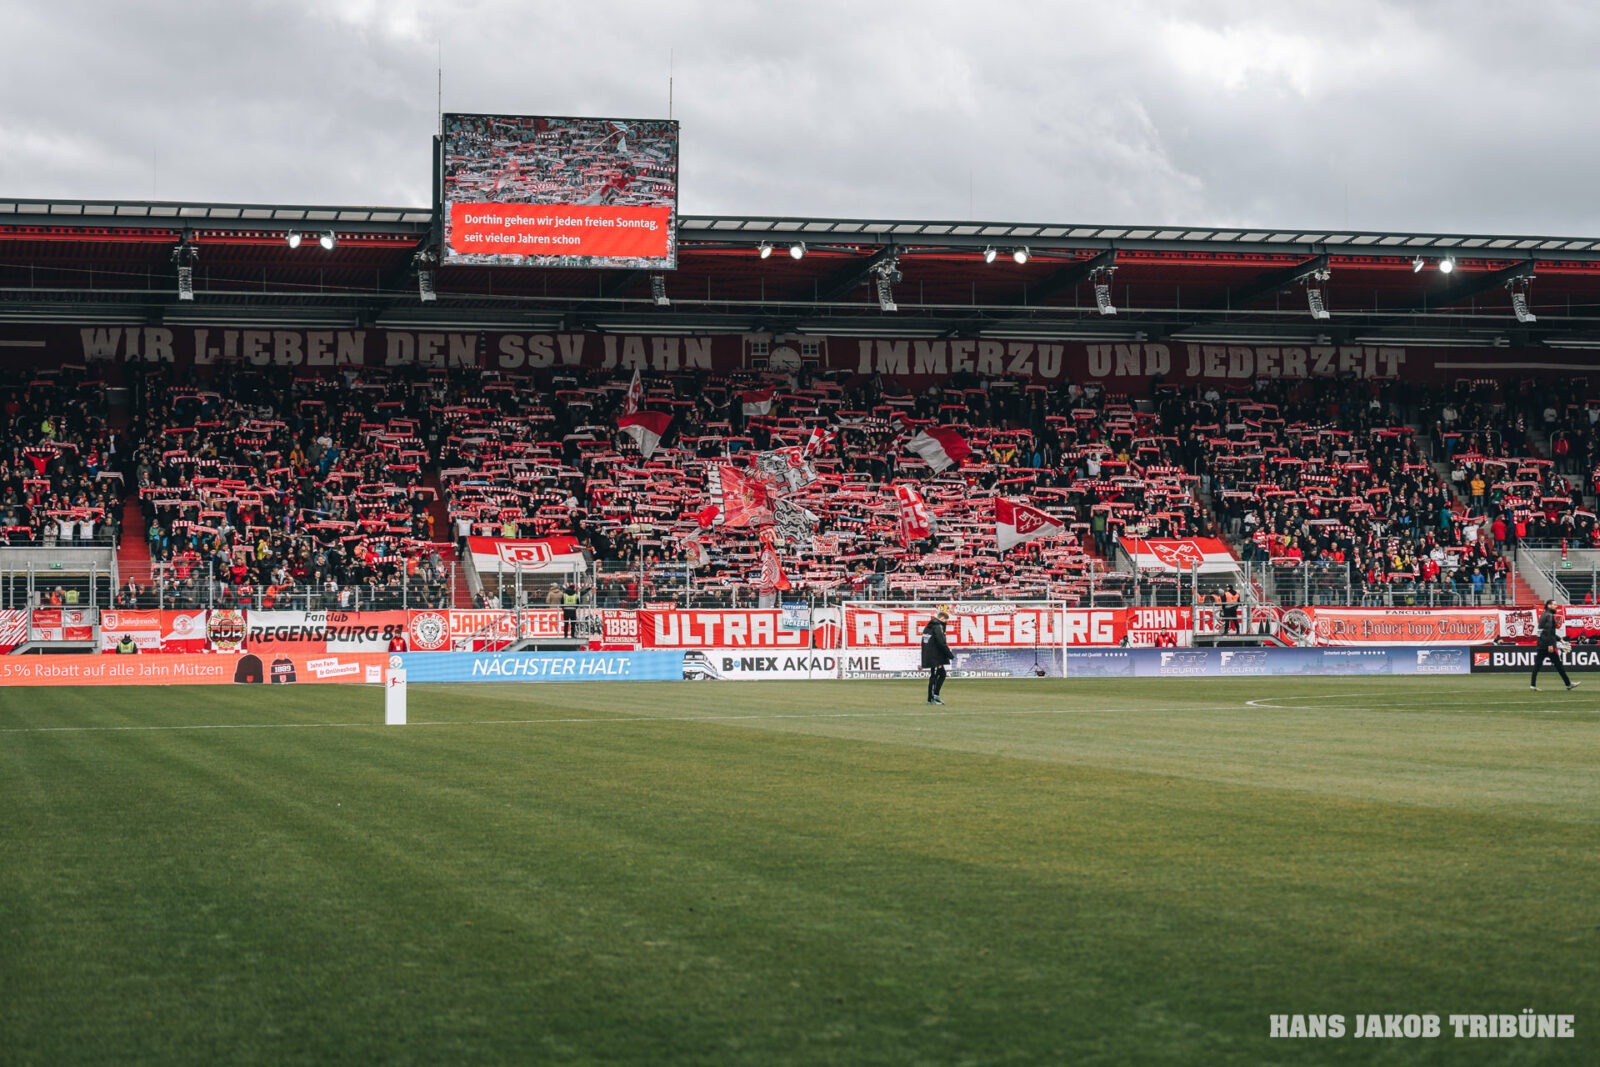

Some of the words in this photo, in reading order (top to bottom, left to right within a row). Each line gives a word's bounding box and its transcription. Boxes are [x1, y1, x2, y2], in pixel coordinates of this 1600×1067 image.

[464, 214, 503, 225] Dorthin
[504, 215, 535, 228] gehen
[537, 216, 553, 226] wir
[554, 215, 583, 229] jeden
[584, 216, 615, 228] freien
[616, 217, 659, 231] Sonntag,
[464, 233, 484, 243] seit
[485, 232, 516, 244] vielen
[517, 233, 551, 245] Jahren
[552, 234, 581, 245] schon
[80, 327, 175, 363] WIR
[194, 329, 366, 367] LIEBEN
[384, 332, 480, 368] DEN
[500, 335, 586, 369] SSV
[602, 336, 713, 372] JAHN
[858, 338, 1064, 377] IMMERZU
[1086, 344, 1171, 377] UND
[1186, 345, 1406, 379] JEDERZEIT
[304, 611, 349, 622] Fanclub
[604, 610, 618, 618] SSV
[619, 610, 637, 618] JAHN
[1133, 609, 1177, 629] JAHN
[249, 624, 378, 644] REGENSBURG
[604, 619, 638, 635] 1889
[654, 613, 801, 645] ULTRAS
[1333, 619, 1357, 635] Die
[1362, 619, 1404, 638] Power
[1408, 619, 1434, 635] vom
[1133, 631, 1178, 644] STADN
[472, 657, 577, 676] NÄCHSTER
[578, 658, 631, 675] HALT:
[783, 656, 881, 671] AKADEMIE
[1493, 651, 1600, 667] BUNLIGA
[0, 664, 12, 677] 5
[14, 664, 31, 677] %
[35, 663, 83, 677] Rabatt
[86, 663, 107, 677] auf
[110, 663, 134, 677] alle
[138, 663, 169, 677] Jahn
[173, 662, 224, 676] Mützen
[274, 665, 292, 673] 1889
[853, 671, 895, 679] Dallmeier
[970, 670, 1011, 678] Dallmeier
